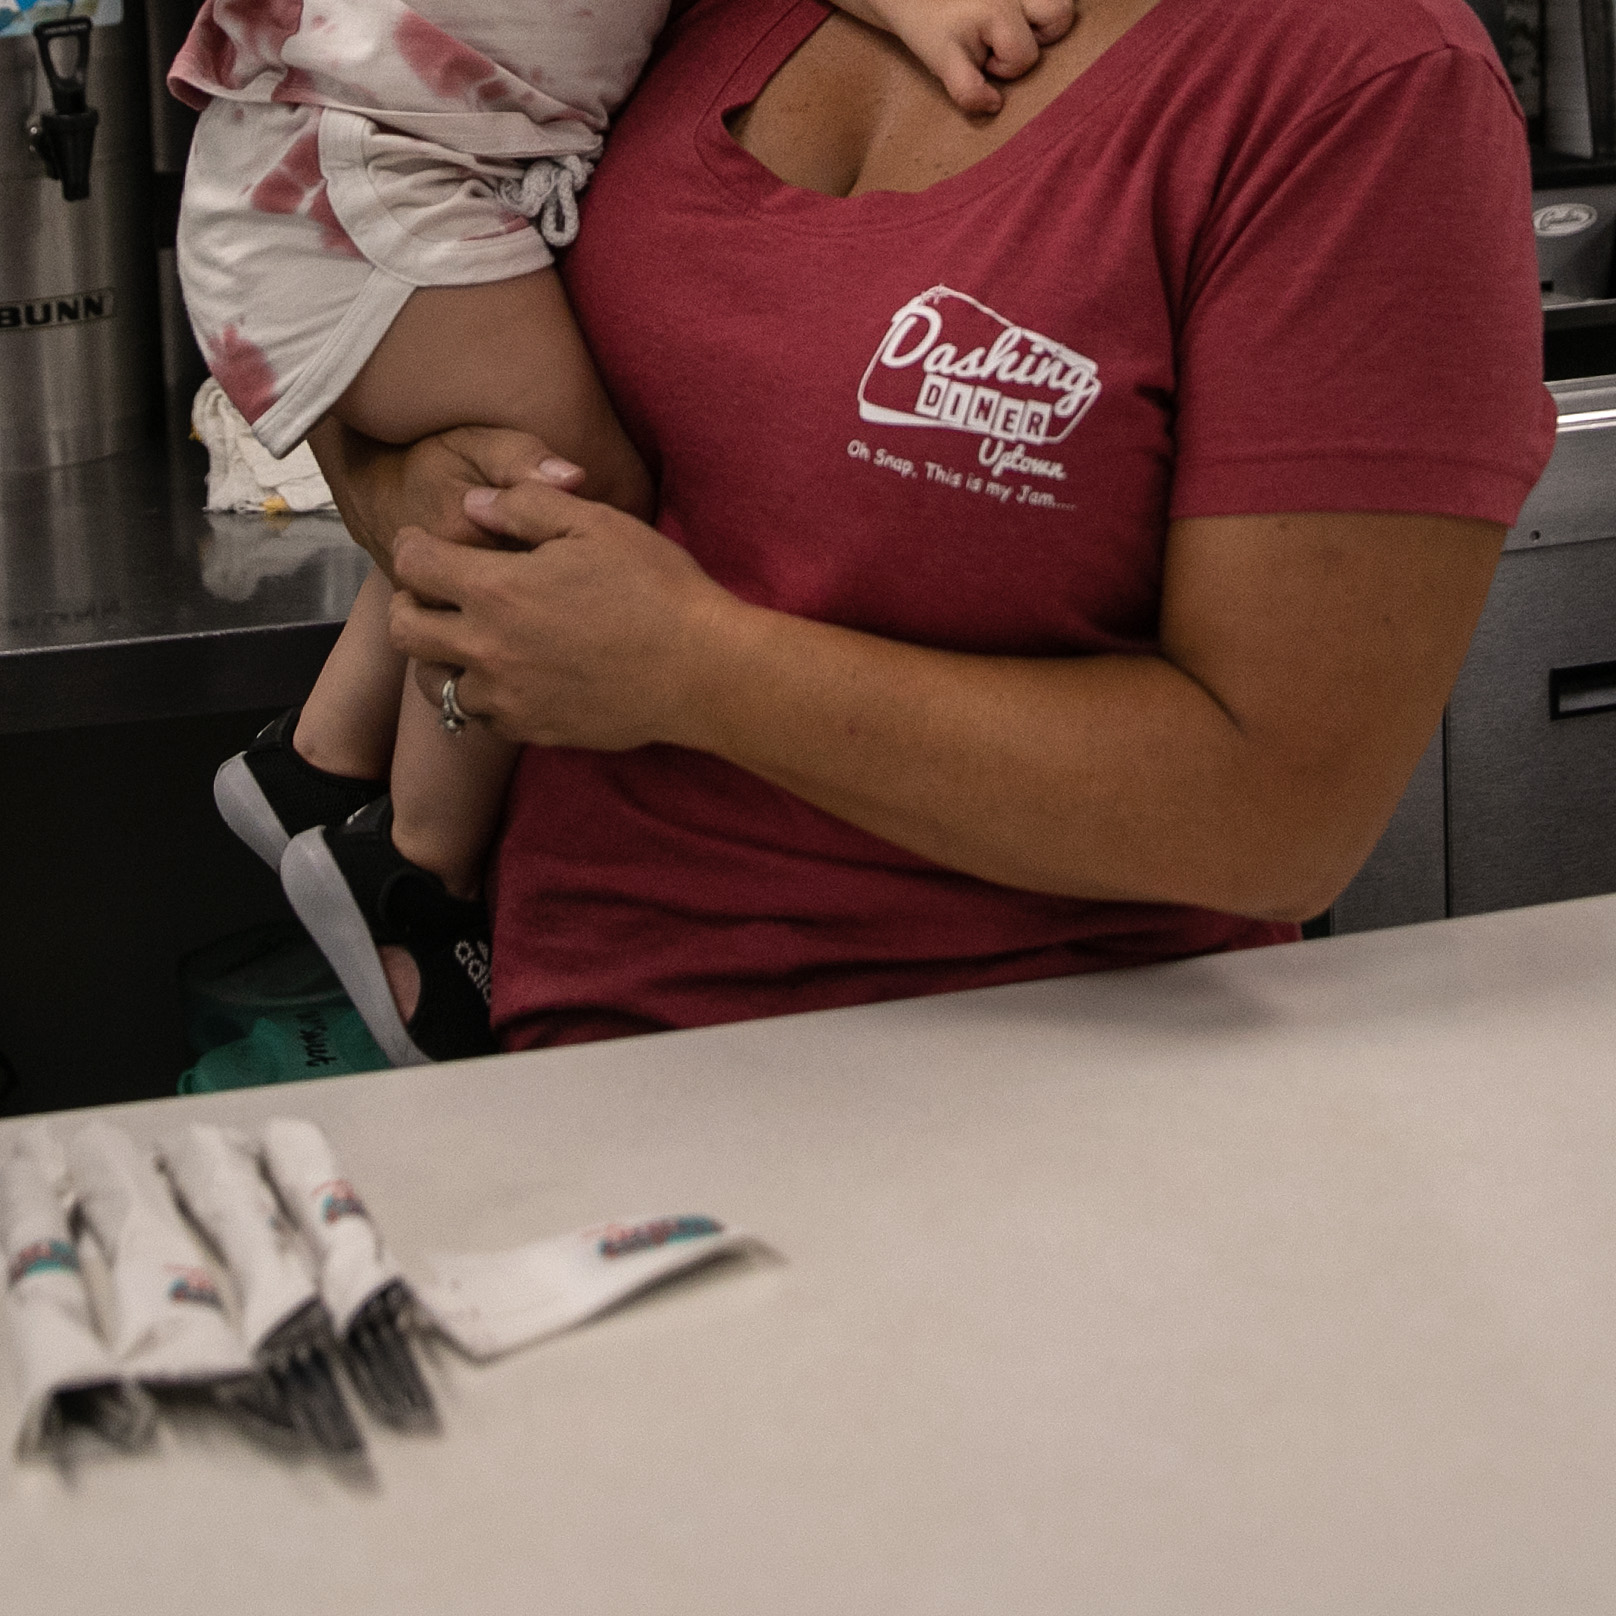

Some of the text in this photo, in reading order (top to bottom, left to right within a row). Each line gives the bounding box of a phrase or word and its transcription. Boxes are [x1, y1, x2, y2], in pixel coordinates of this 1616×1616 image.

[881, 304, 1097, 418] Dashing
[922, 382, 1046, 442] DINER
[846, 439, 872, 462] Oh
[924, 461, 964, 489] This
[966, 472, 984, 494] is
[985, 481, 1014, 503] my
[978, 437, 1067, 481] Uptown
